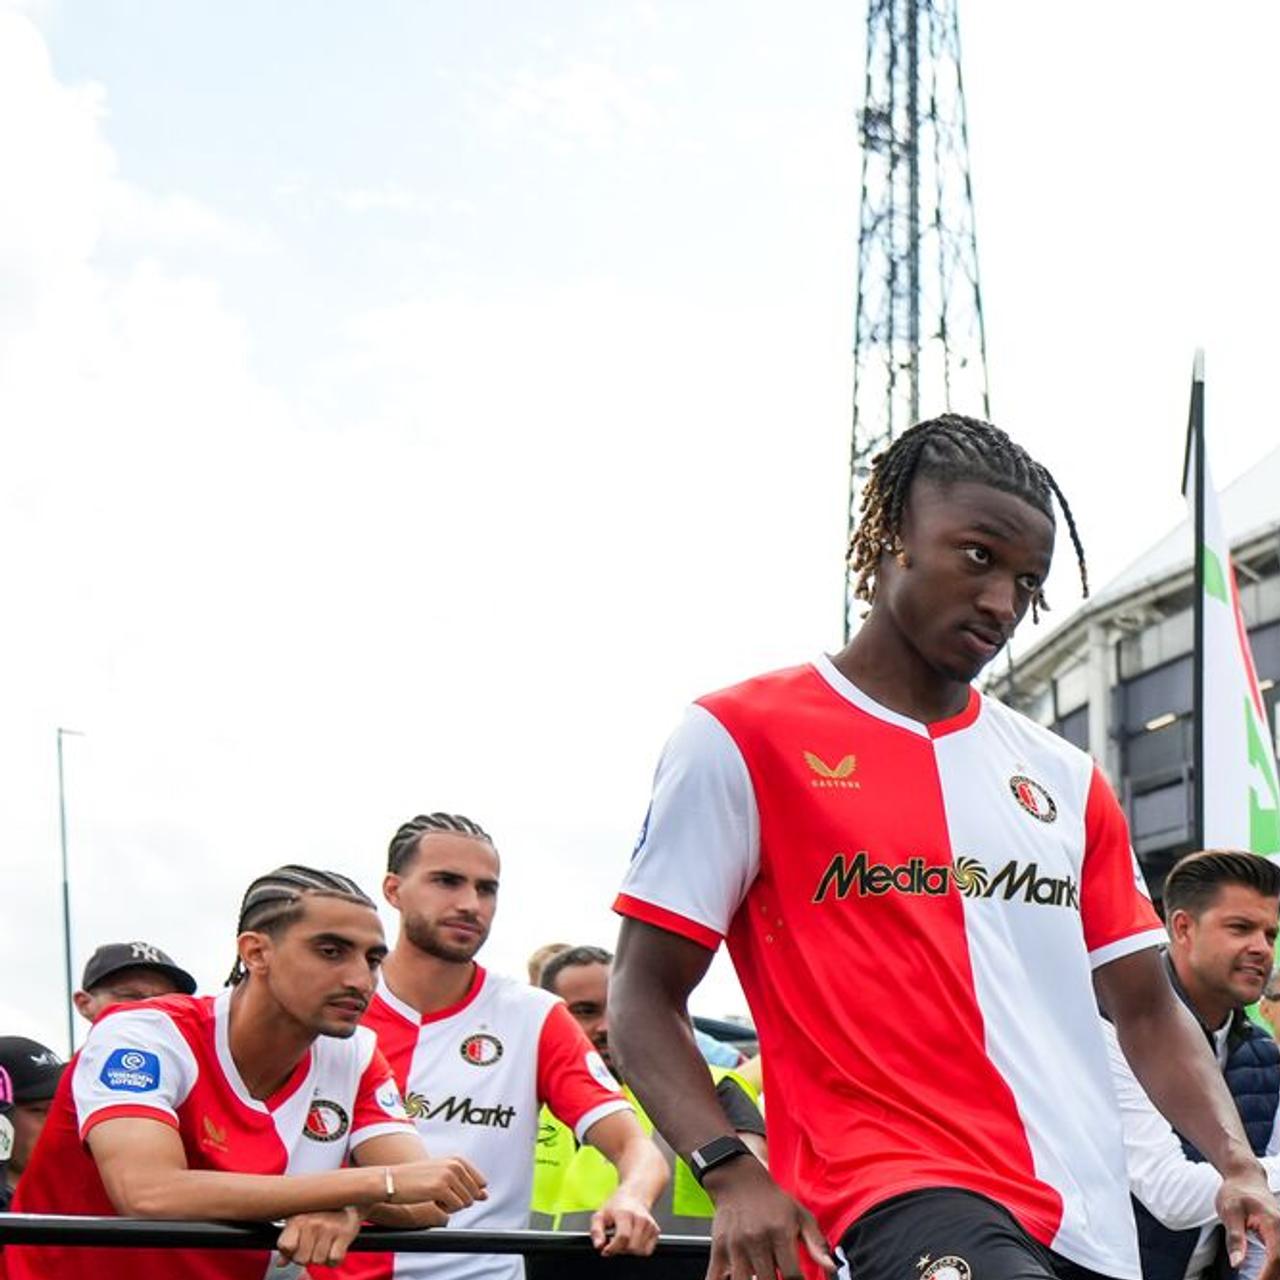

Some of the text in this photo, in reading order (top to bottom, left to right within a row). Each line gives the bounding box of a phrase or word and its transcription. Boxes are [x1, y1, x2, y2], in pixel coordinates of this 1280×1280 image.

[812, 851, 1079, 911] Media Mark
[427, 1096, 515, 1128] Markt
